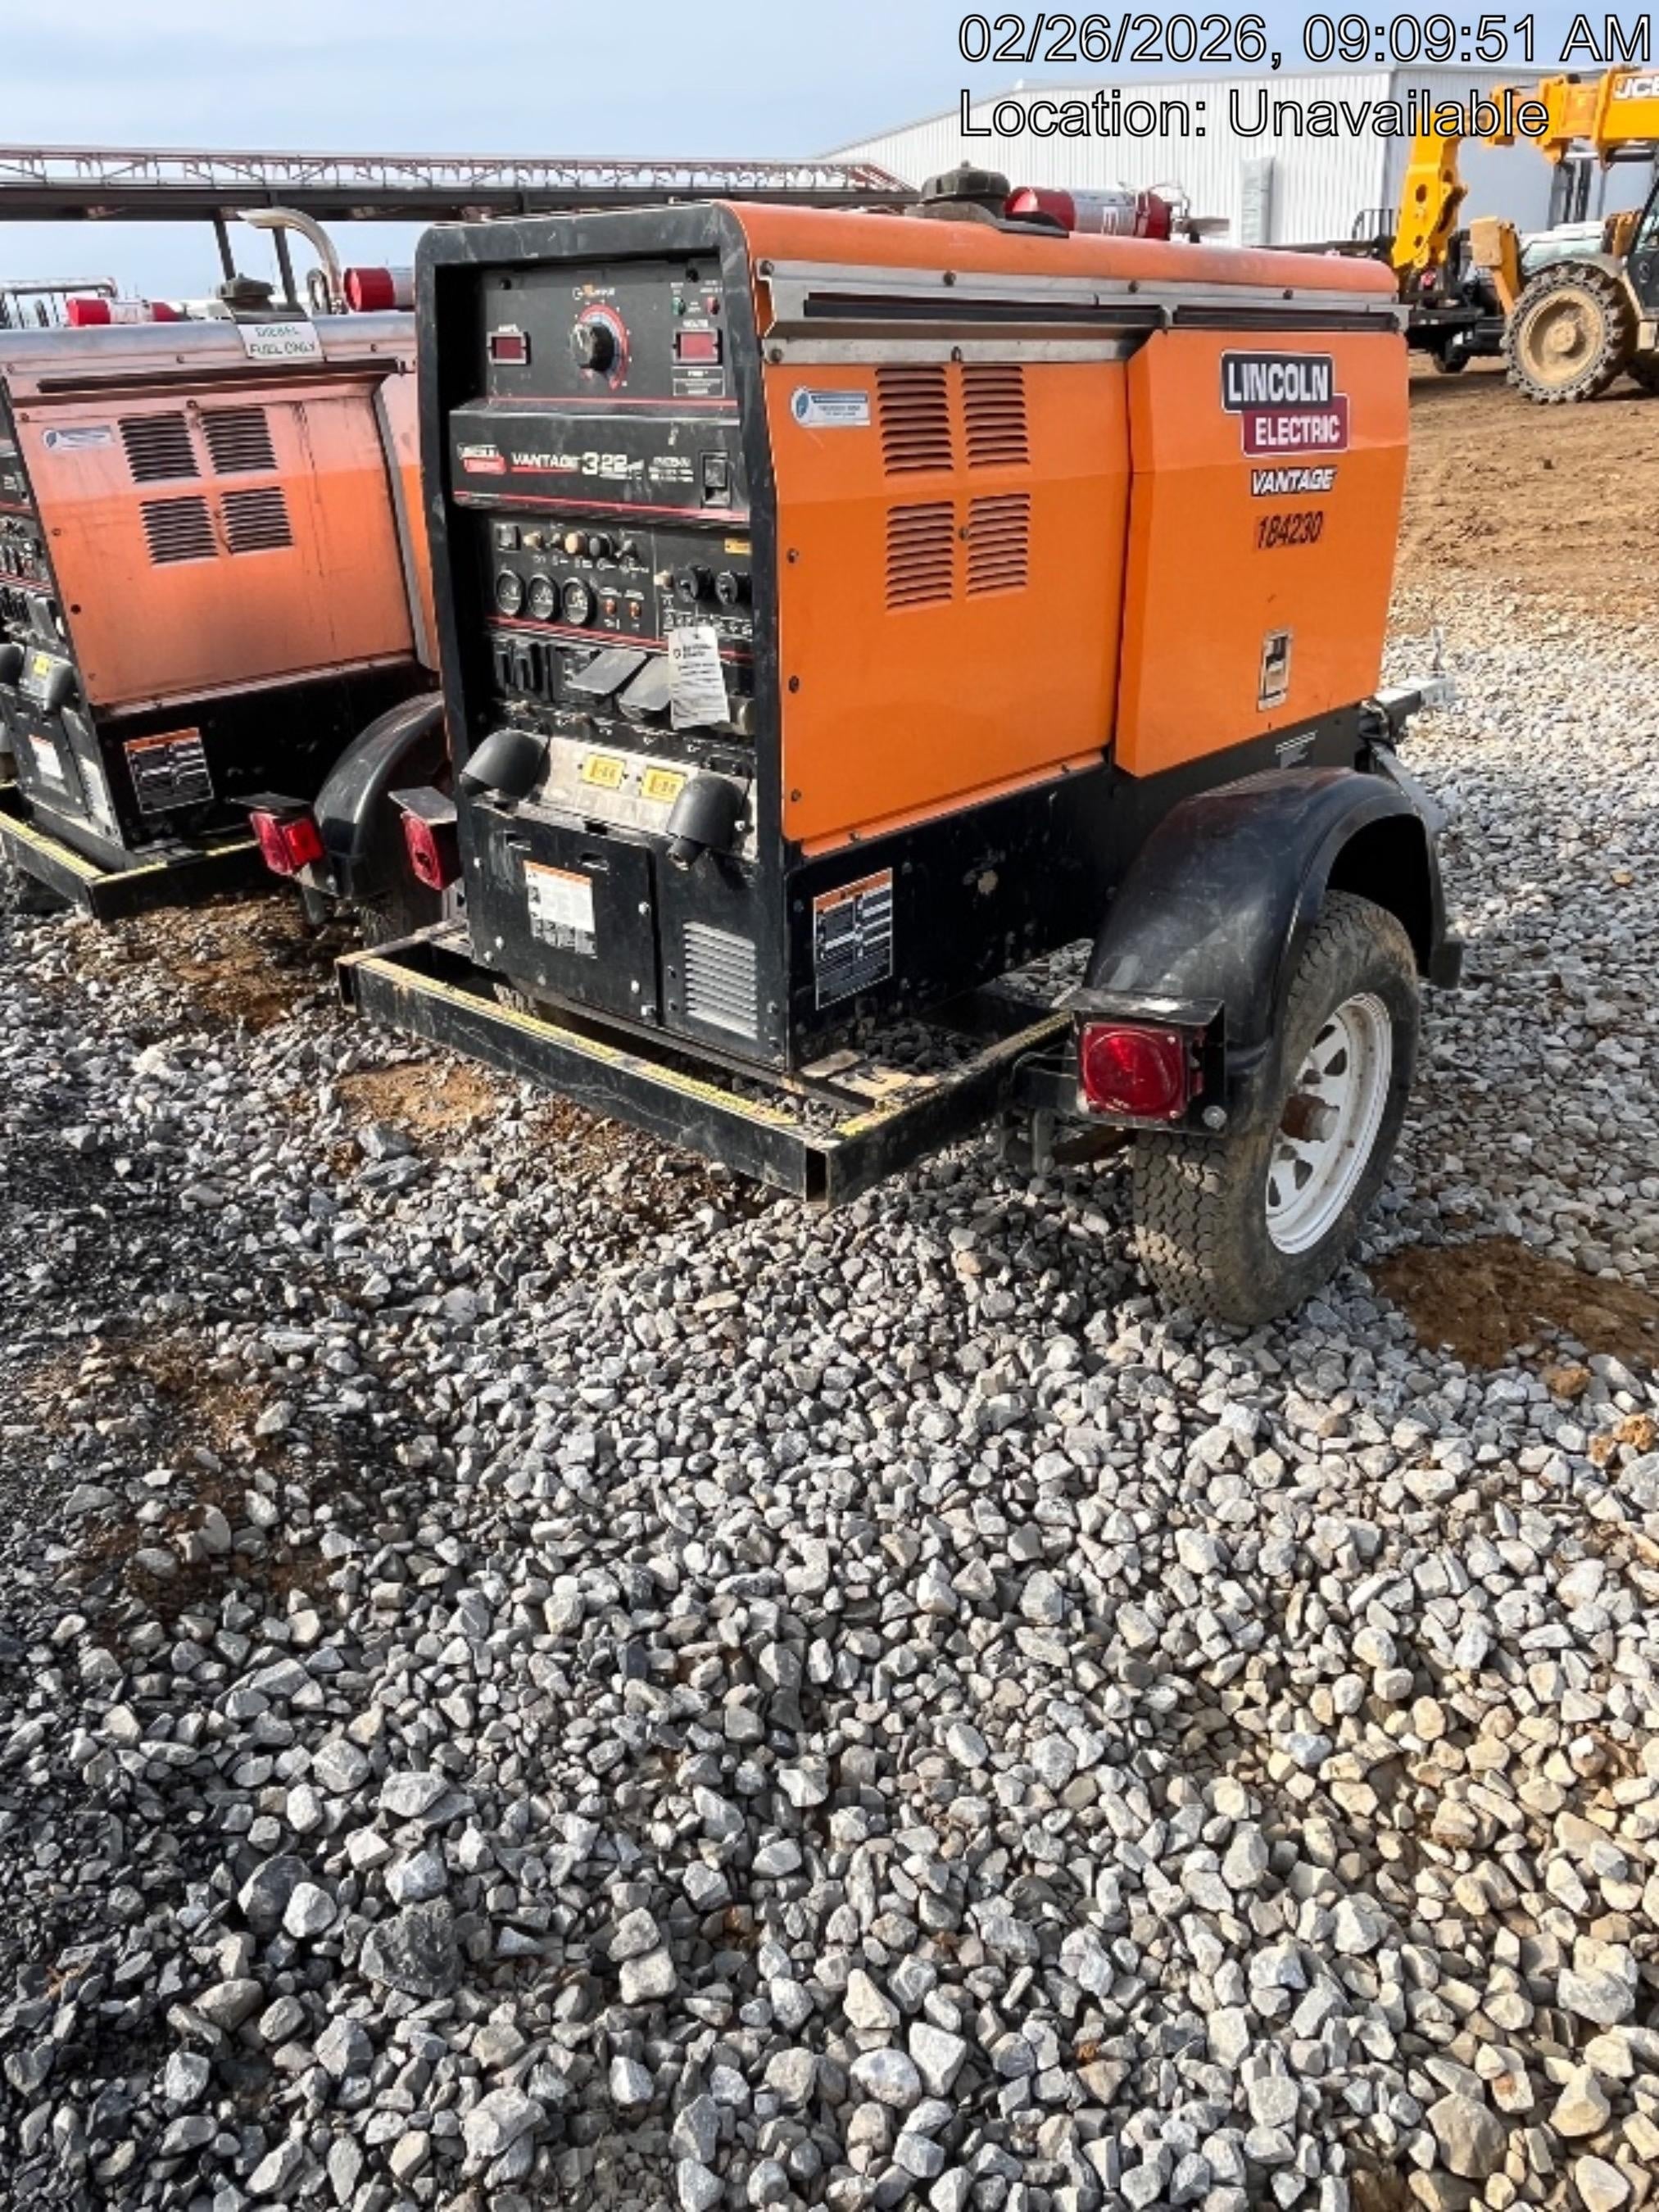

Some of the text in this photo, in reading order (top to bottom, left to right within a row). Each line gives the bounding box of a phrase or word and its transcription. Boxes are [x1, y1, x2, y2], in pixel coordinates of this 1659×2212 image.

[249, 339, 315, 355] FUEL ONLY
[1228, 361, 1329, 402] LINCOLN
[1255, 415, 1340, 446] ELECTRIC
[1252, 467, 1336, 496] VANTAGE
[1258, 510, 1325, 549] 184230
